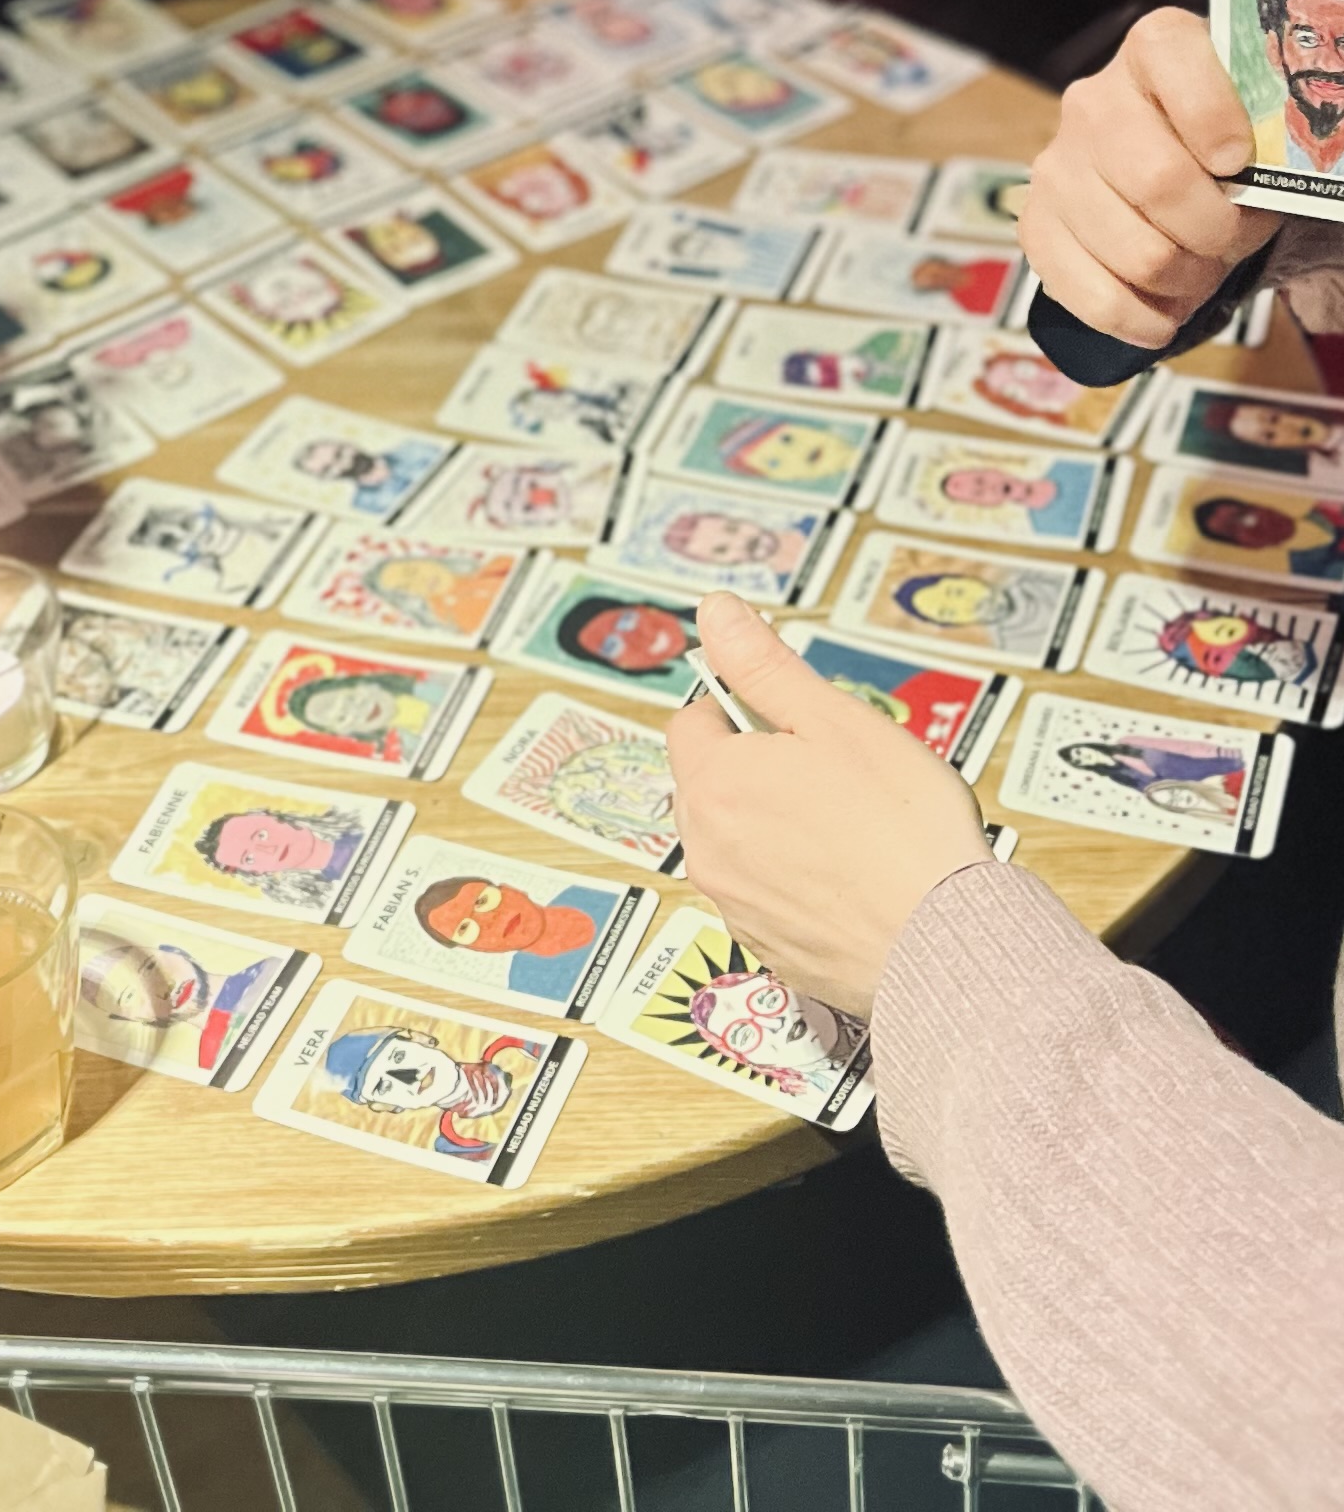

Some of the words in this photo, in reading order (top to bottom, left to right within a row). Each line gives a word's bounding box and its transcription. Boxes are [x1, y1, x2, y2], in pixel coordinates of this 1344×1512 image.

[1253, 171, 1307, 192] NEUBAD
[503, 727, 539, 764] NORA
[139, 787, 188, 855] FABIENNE
[372, 879, 413, 933] FABIAN
[575, 965, 603, 1007] RODTEGG
[632, 945, 679, 996] TERESA
[261, 985, 283, 1010] TEAM
[293, 1026, 329, 1068] VERA
[507, 1112, 533, 1153] NEUBAD
[527, 1060, 559, 1112] NUTZENDE
[828, 1070, 860, 1112] RODTEGG
